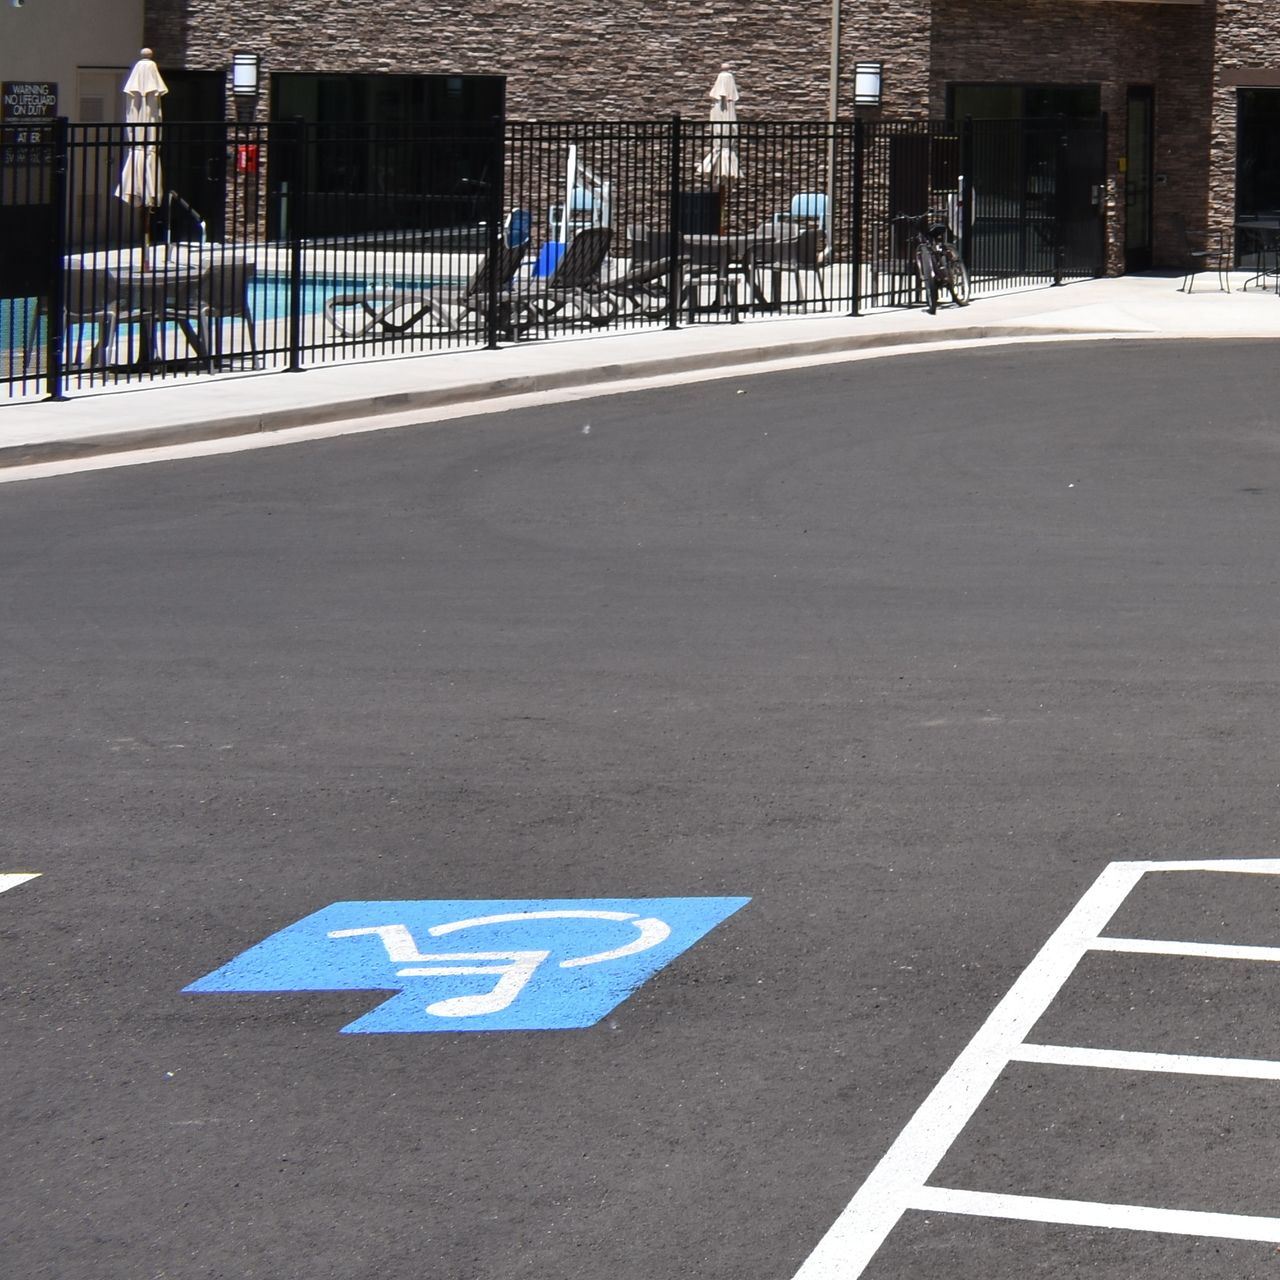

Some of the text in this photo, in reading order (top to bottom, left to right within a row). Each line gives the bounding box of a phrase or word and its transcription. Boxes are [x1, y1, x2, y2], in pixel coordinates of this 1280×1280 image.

[12, 85, 49, 95] WARNING
[5, 94, 56, 105] NO LIFEGUARD
[13, 105, 47, 115] ON DUTY
